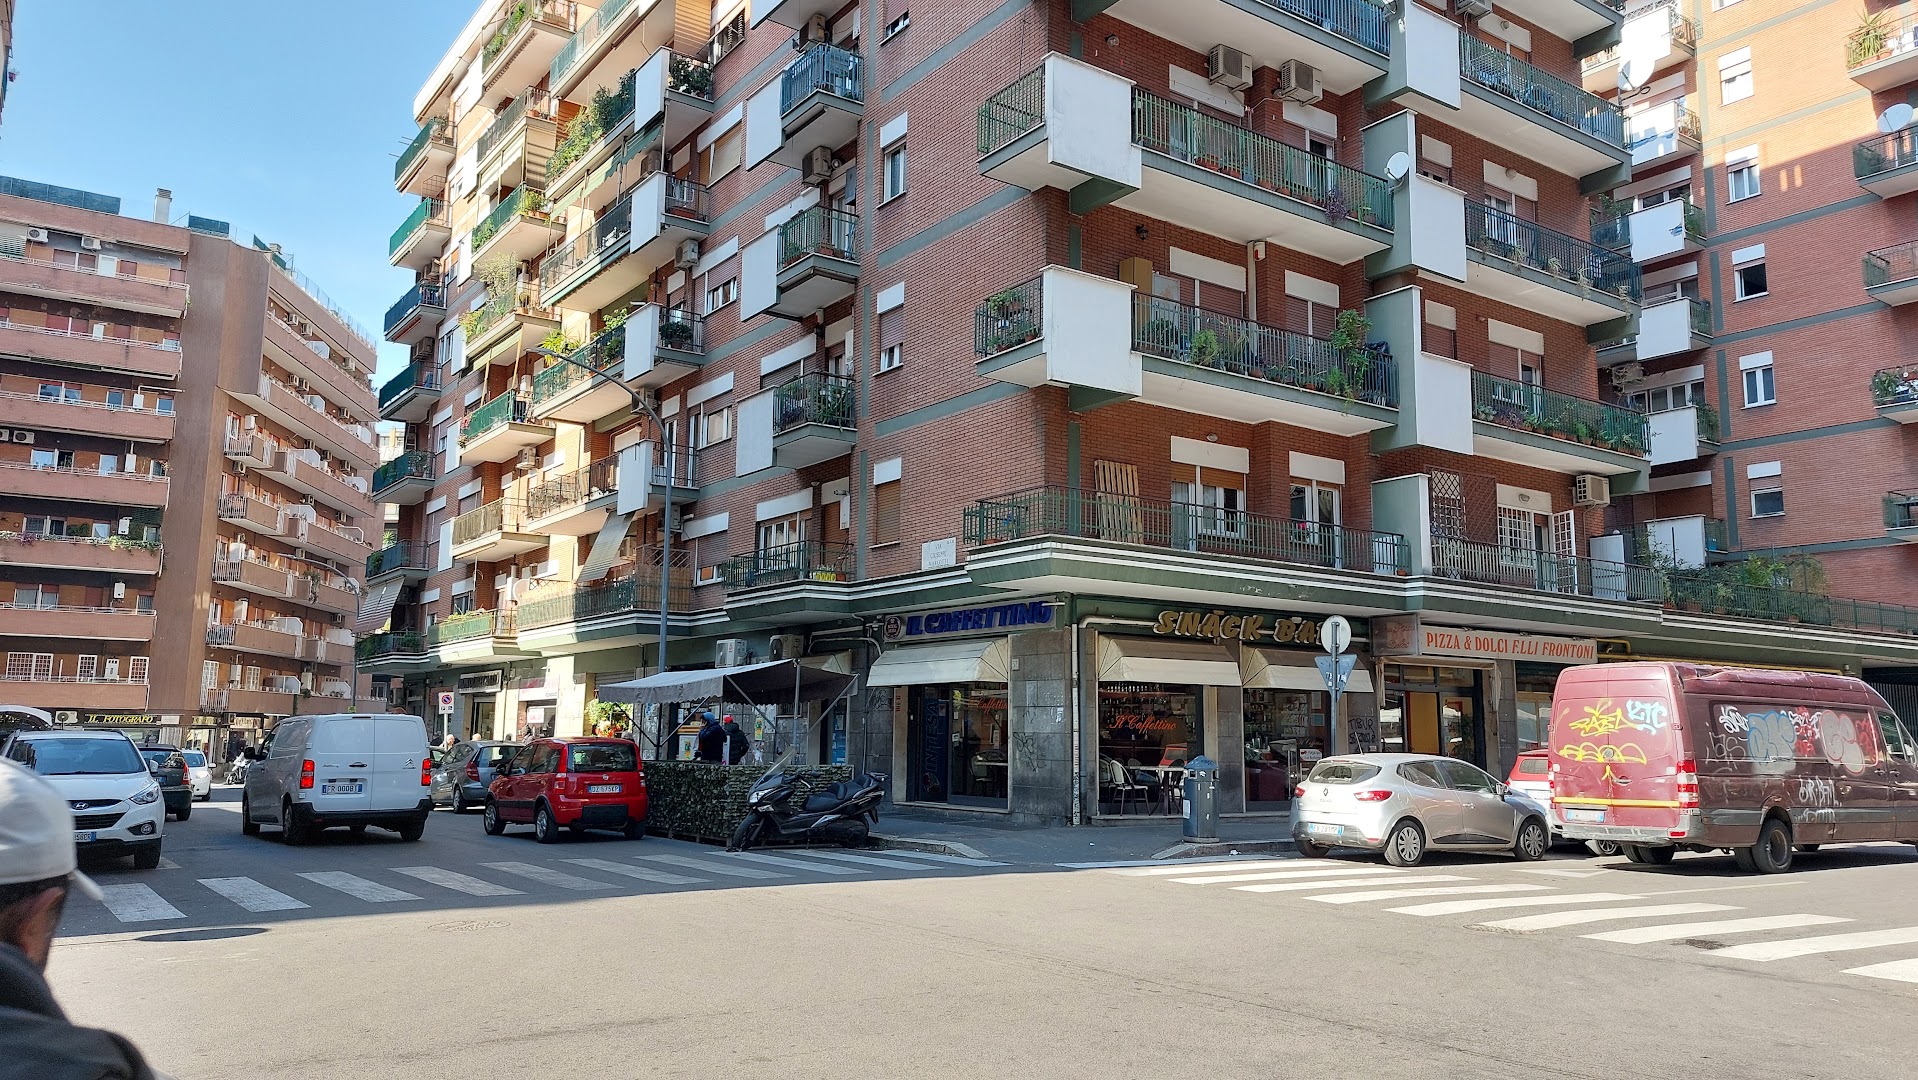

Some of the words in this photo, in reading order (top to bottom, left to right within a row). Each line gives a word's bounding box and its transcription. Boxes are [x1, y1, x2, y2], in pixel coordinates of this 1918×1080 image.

[906, 615, 923, 635] IL
[924, 601, 1053, 634] CAFFETTINO
[1153, 610, 1264, 641] SNACK
[1426, 632, 1460, 650] PIZZA
[1464, 635, 1472, 650] &
[1475, 637, 1508, 653] DOLCI
[1512, 640, 1539, 655] F.LLI
[1542, 641, 1595, 660] FRONTONI
[88, 714, 99, 723] IL
[103, 714, 154, 724] FOTOGRAFO
[1126, 713, 1176, 734] Caffettino
